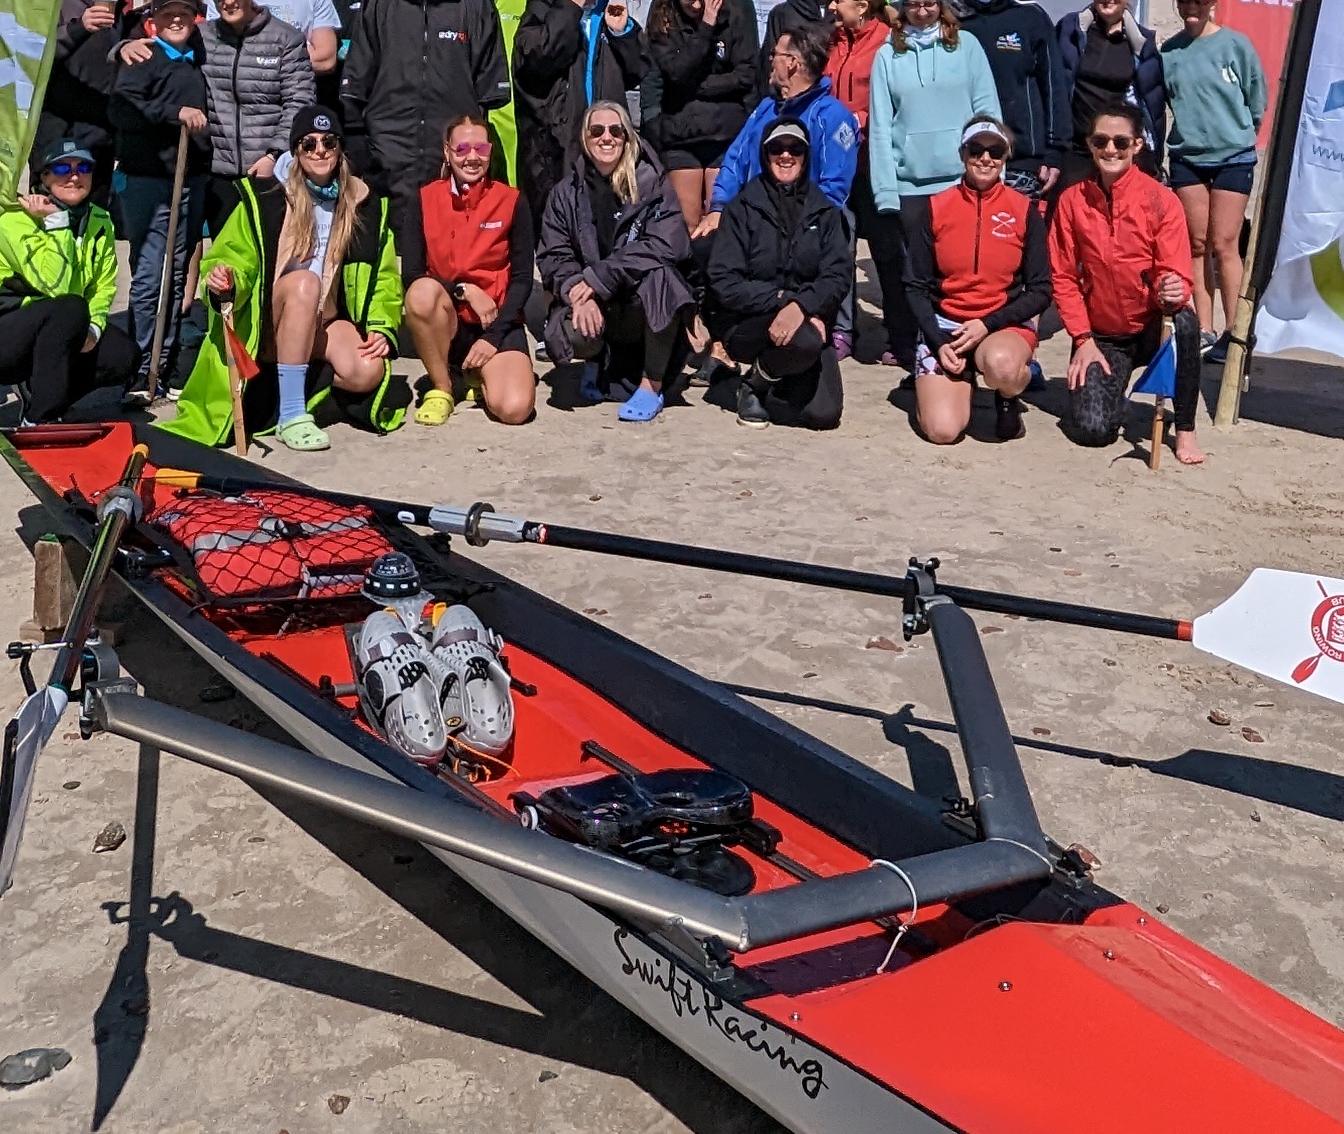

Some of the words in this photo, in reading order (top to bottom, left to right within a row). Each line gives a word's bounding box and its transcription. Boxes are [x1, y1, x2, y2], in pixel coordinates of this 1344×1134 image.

[1312, 625, 1343, 660] ROWING
[614, 927, 700, 1016] Swift
[703, 989, 829, 1098] Racing
